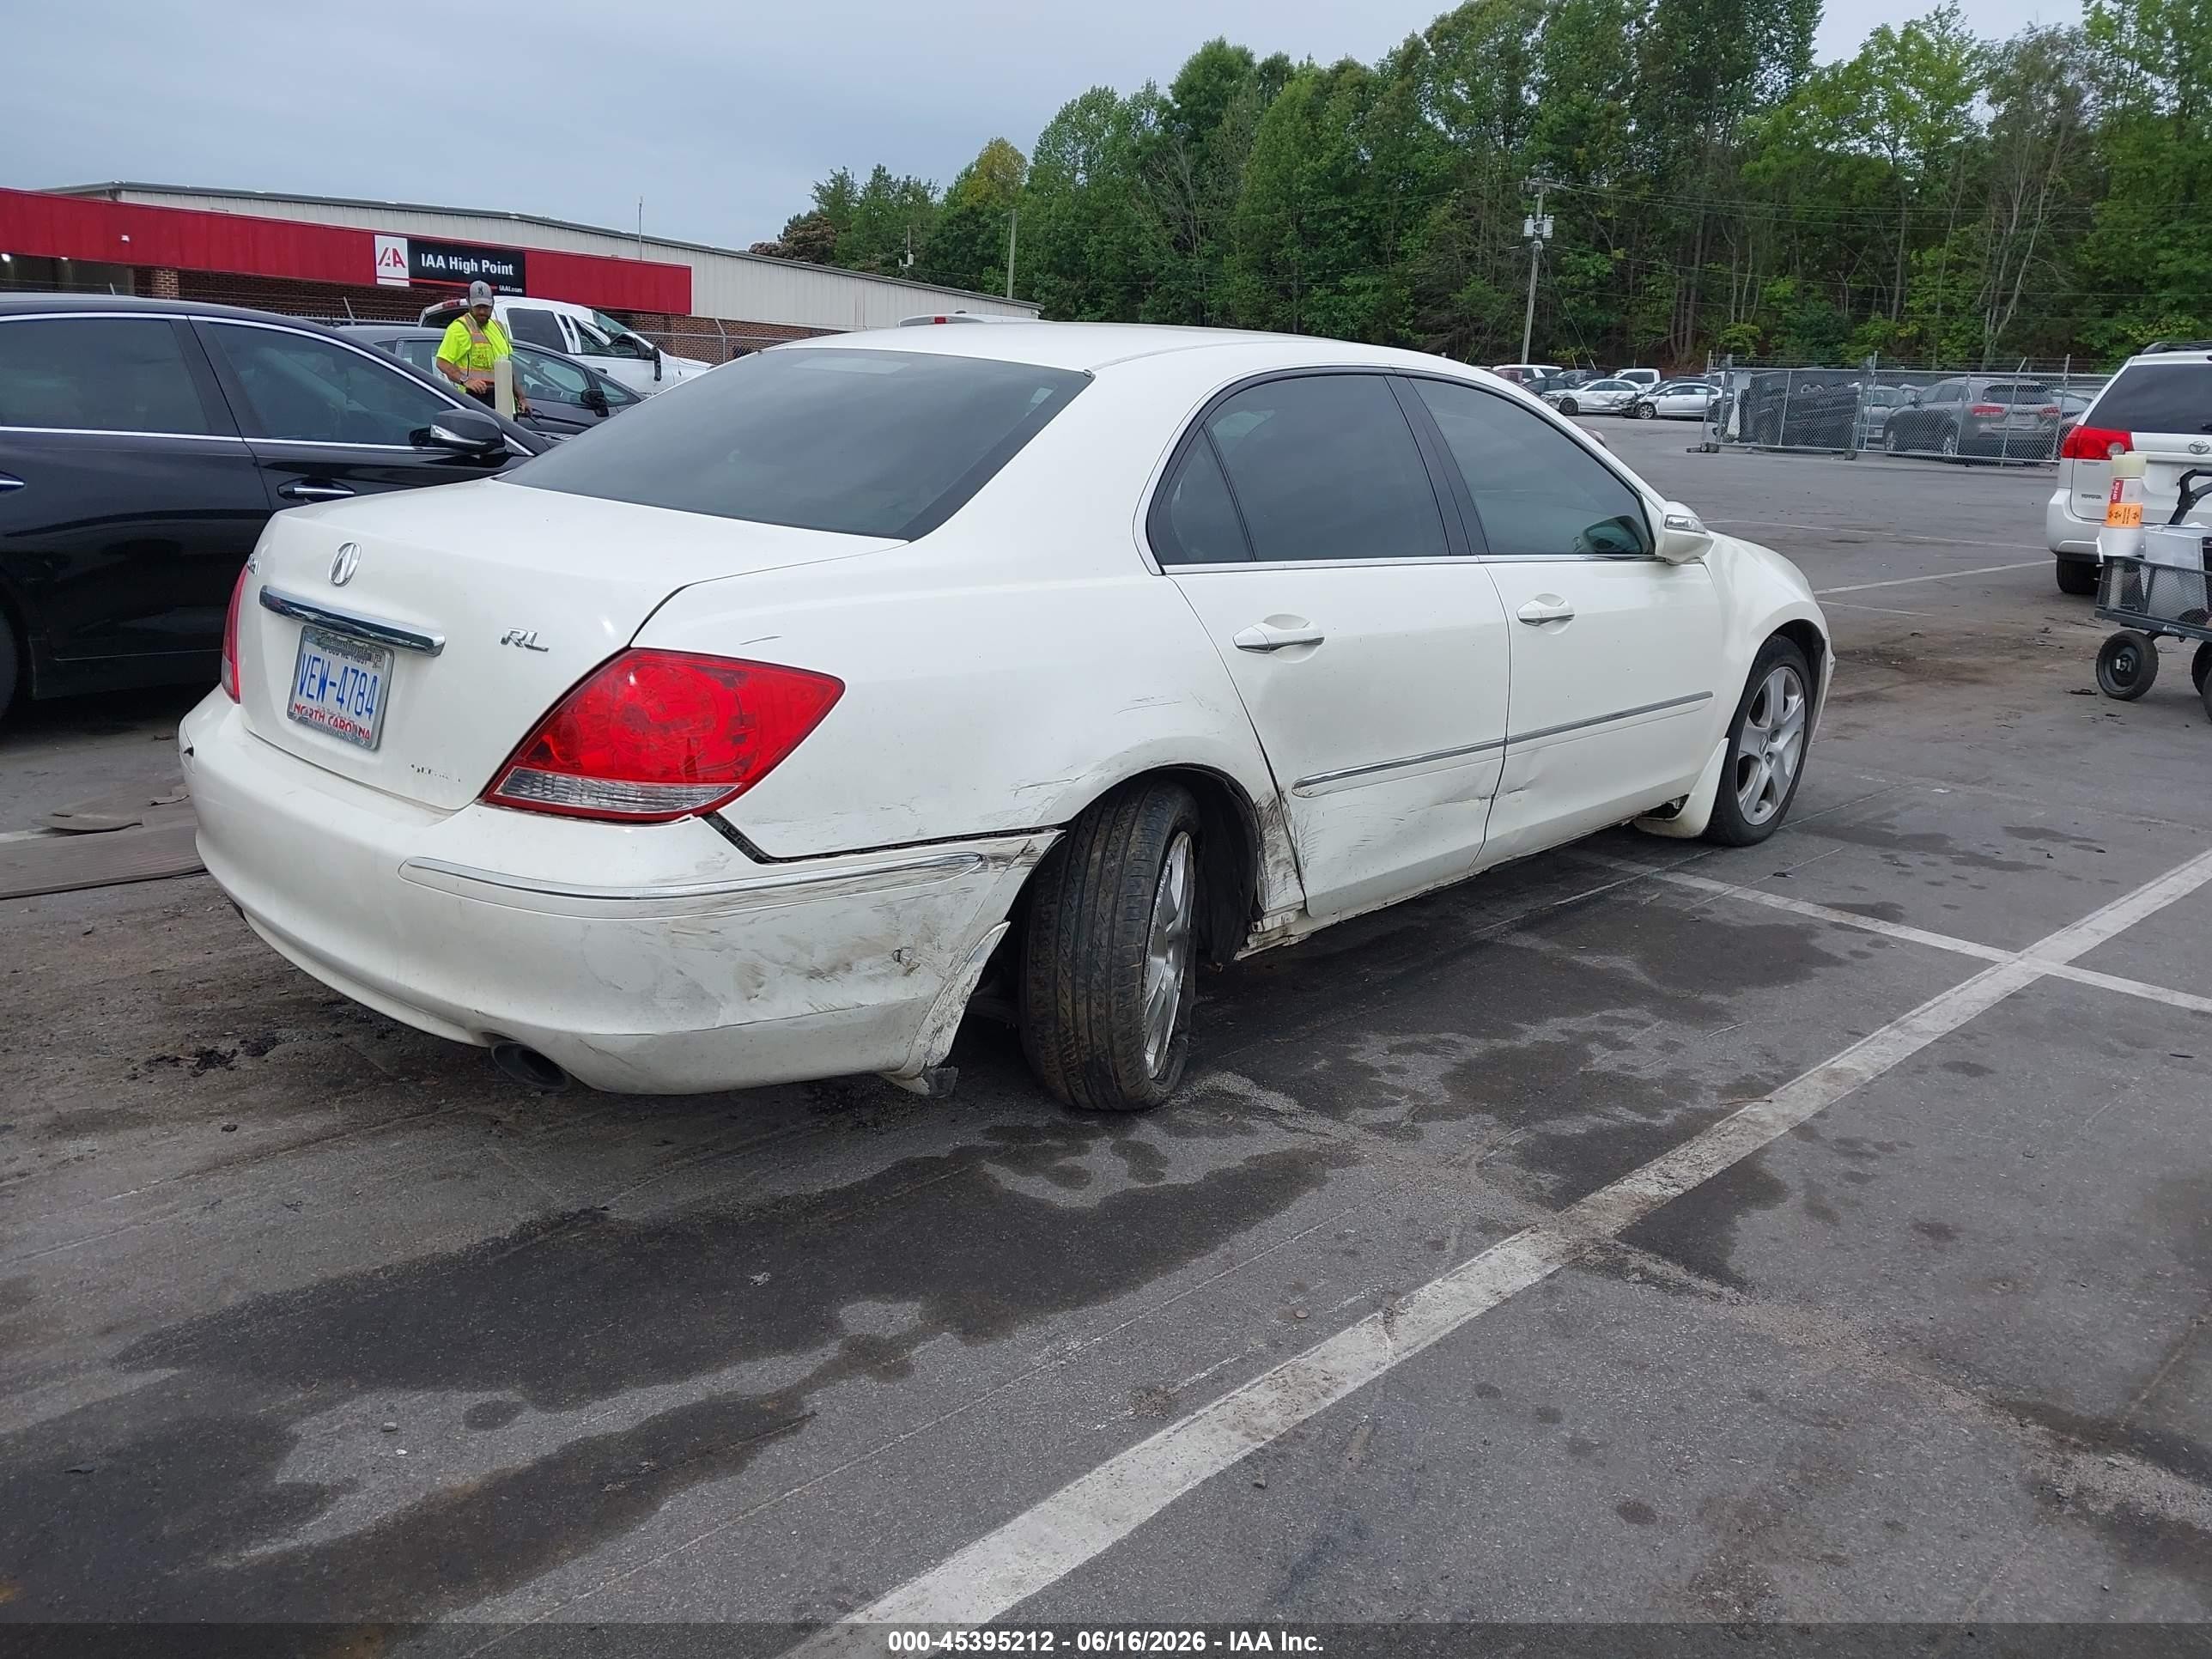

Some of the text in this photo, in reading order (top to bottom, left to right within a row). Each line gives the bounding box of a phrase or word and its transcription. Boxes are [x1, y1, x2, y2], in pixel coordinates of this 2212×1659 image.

[421, 252, 514, 276] IAA High Point
[499, 284, 523, 294] IAAI.com
[500, 627, 550, 653] RL
[298, 652, 379, 720] VEW-4784
[327, 714, 371, 740] CARONA
